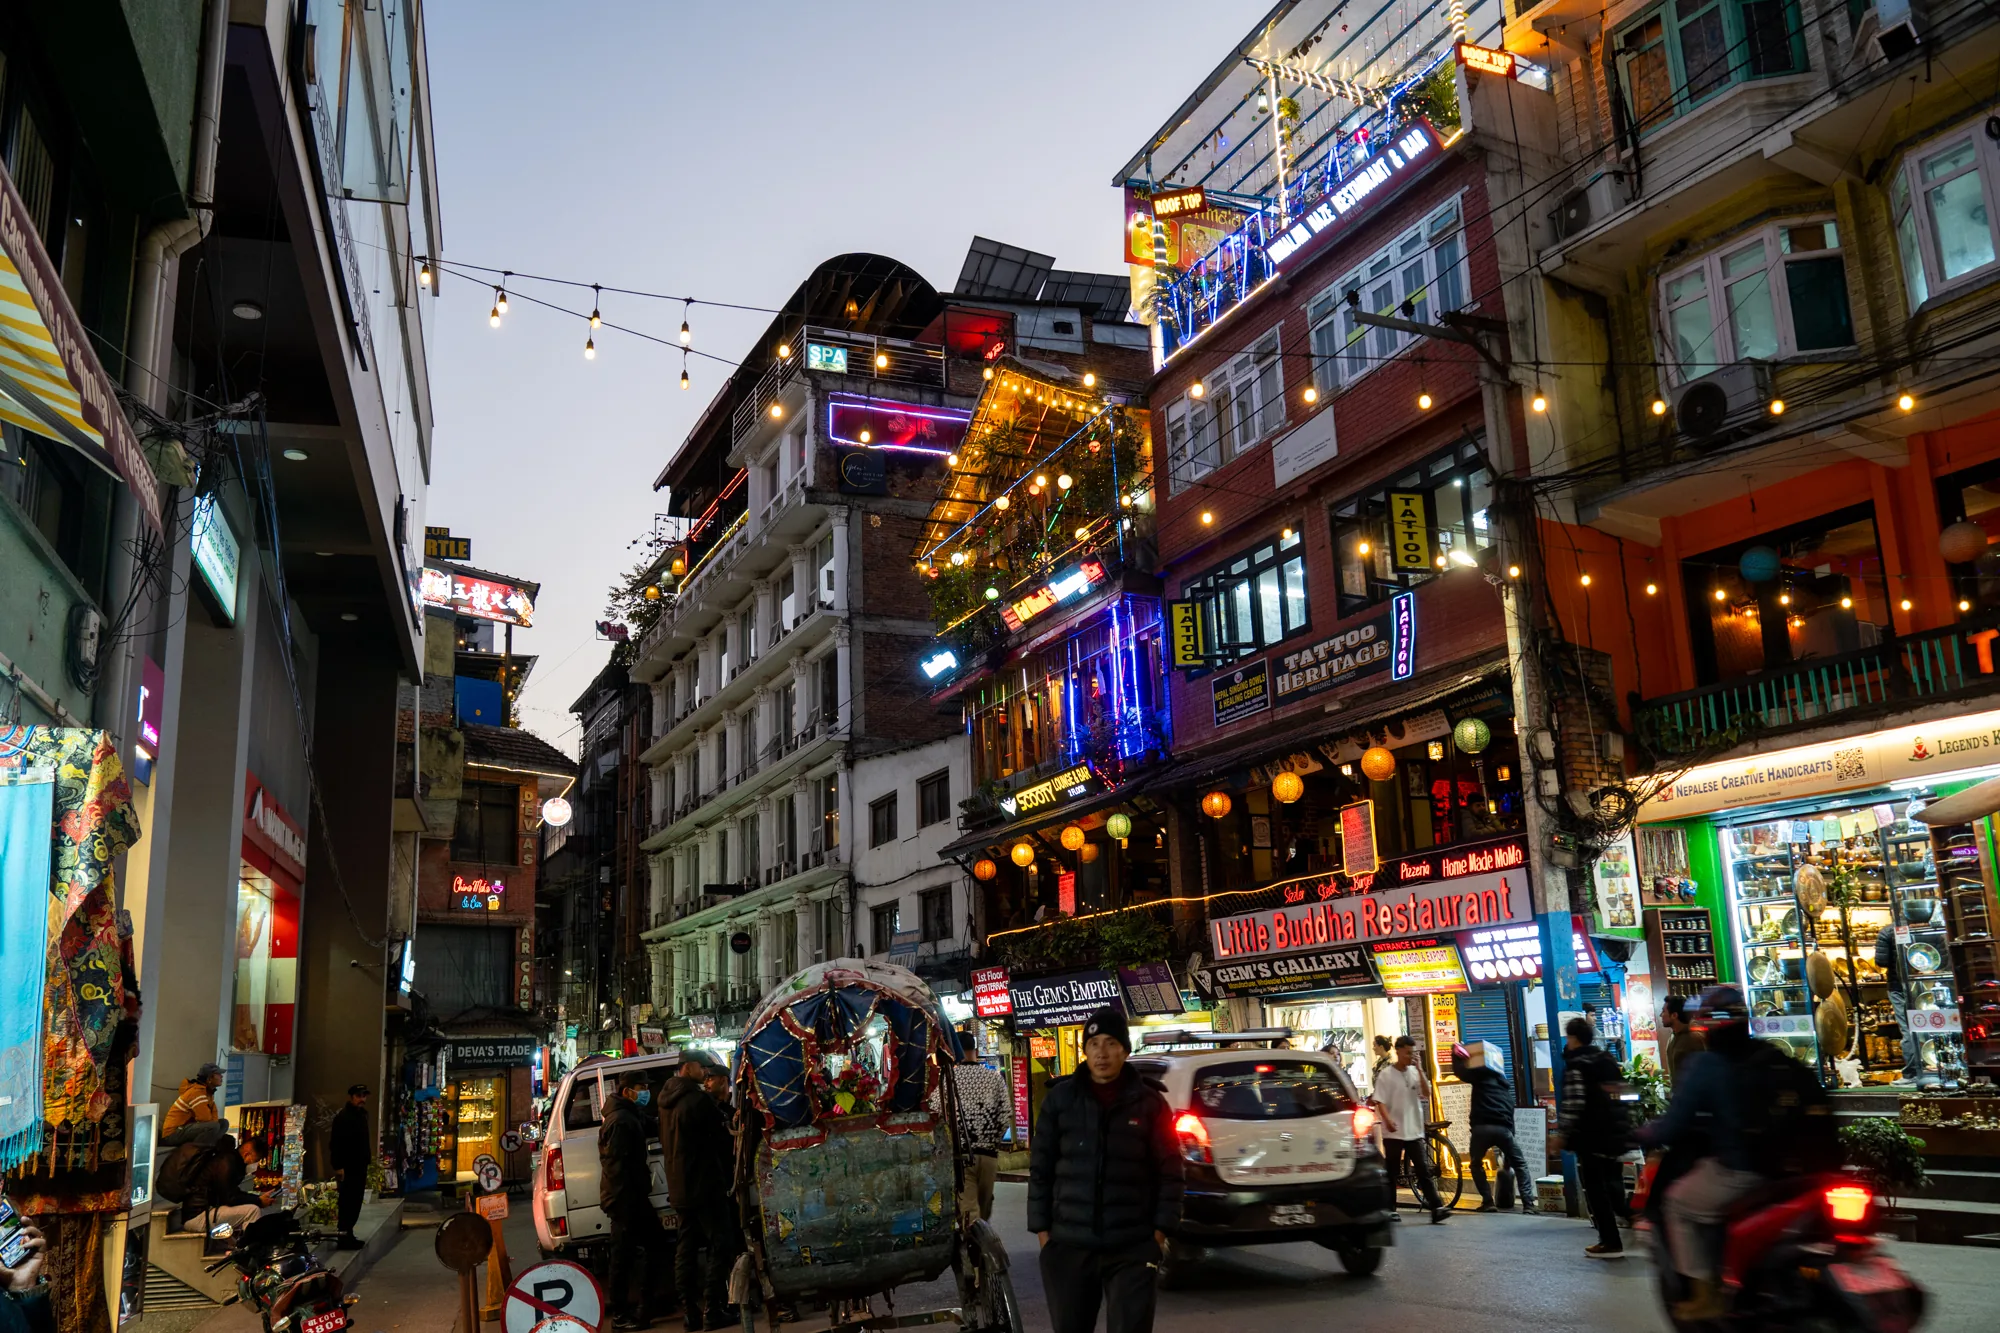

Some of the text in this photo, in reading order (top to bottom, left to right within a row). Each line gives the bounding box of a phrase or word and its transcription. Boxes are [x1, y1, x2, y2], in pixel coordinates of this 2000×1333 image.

[1461, 45, 1512, 69] ROOF TOP
[1331, 157, 1391, 214] RESTAURANT
[1399, 129, 1429, 159] BAR
[1154, 193, 1202, 214] ROOF TOP
[809, 345, 846, 364] SPA
[425, 527, 449, 536] LUB
[1399, 497, 1421, 564] TATTOO
[425, 539, 468, 558] RTLE
[1180, 606, 1194, 662] TATTOO
[1397, 598, 1409, 675] TATTOO
[1284, 624, 1377, 671] TATTOO
[1276, 640, 1390, 696] HERITAGE
[1243, 685, 1263, 699] CENTER
[1938, 730, 2000, 755] LEGEND'S K
[1016, 782, 1056, 811] SCOOTY
[1051, 770, 1075, 791] LOUNGE
[1077, 766, 1092, 782] BAR
[1676, 760, 1832, 797] NEPALESE CREATIVE HANDICRAFTS
[1401, 845, 1522, 879] Pizzeria Home Made MoMo
[1215, 876, 1513, 957] Little Buddha Restaurant
[1373, 941, 1411, 952] ENTRANCE
[977, 971, 1004, 982] 1st Floor
[1216, 962, 1271, 983] GEM'S
[1273, 950, 1361, 975] GALLERY
[975, 984, 988, 994] OPEN
[976, 995, 991, 1005] Little
[1010, 979, 1120, 1008] THE GEM'S EMPIRE
[1433, 997, 1454, 1006] CARGO
[457, 1045, 530, 1057] DEVA'S TRADE
